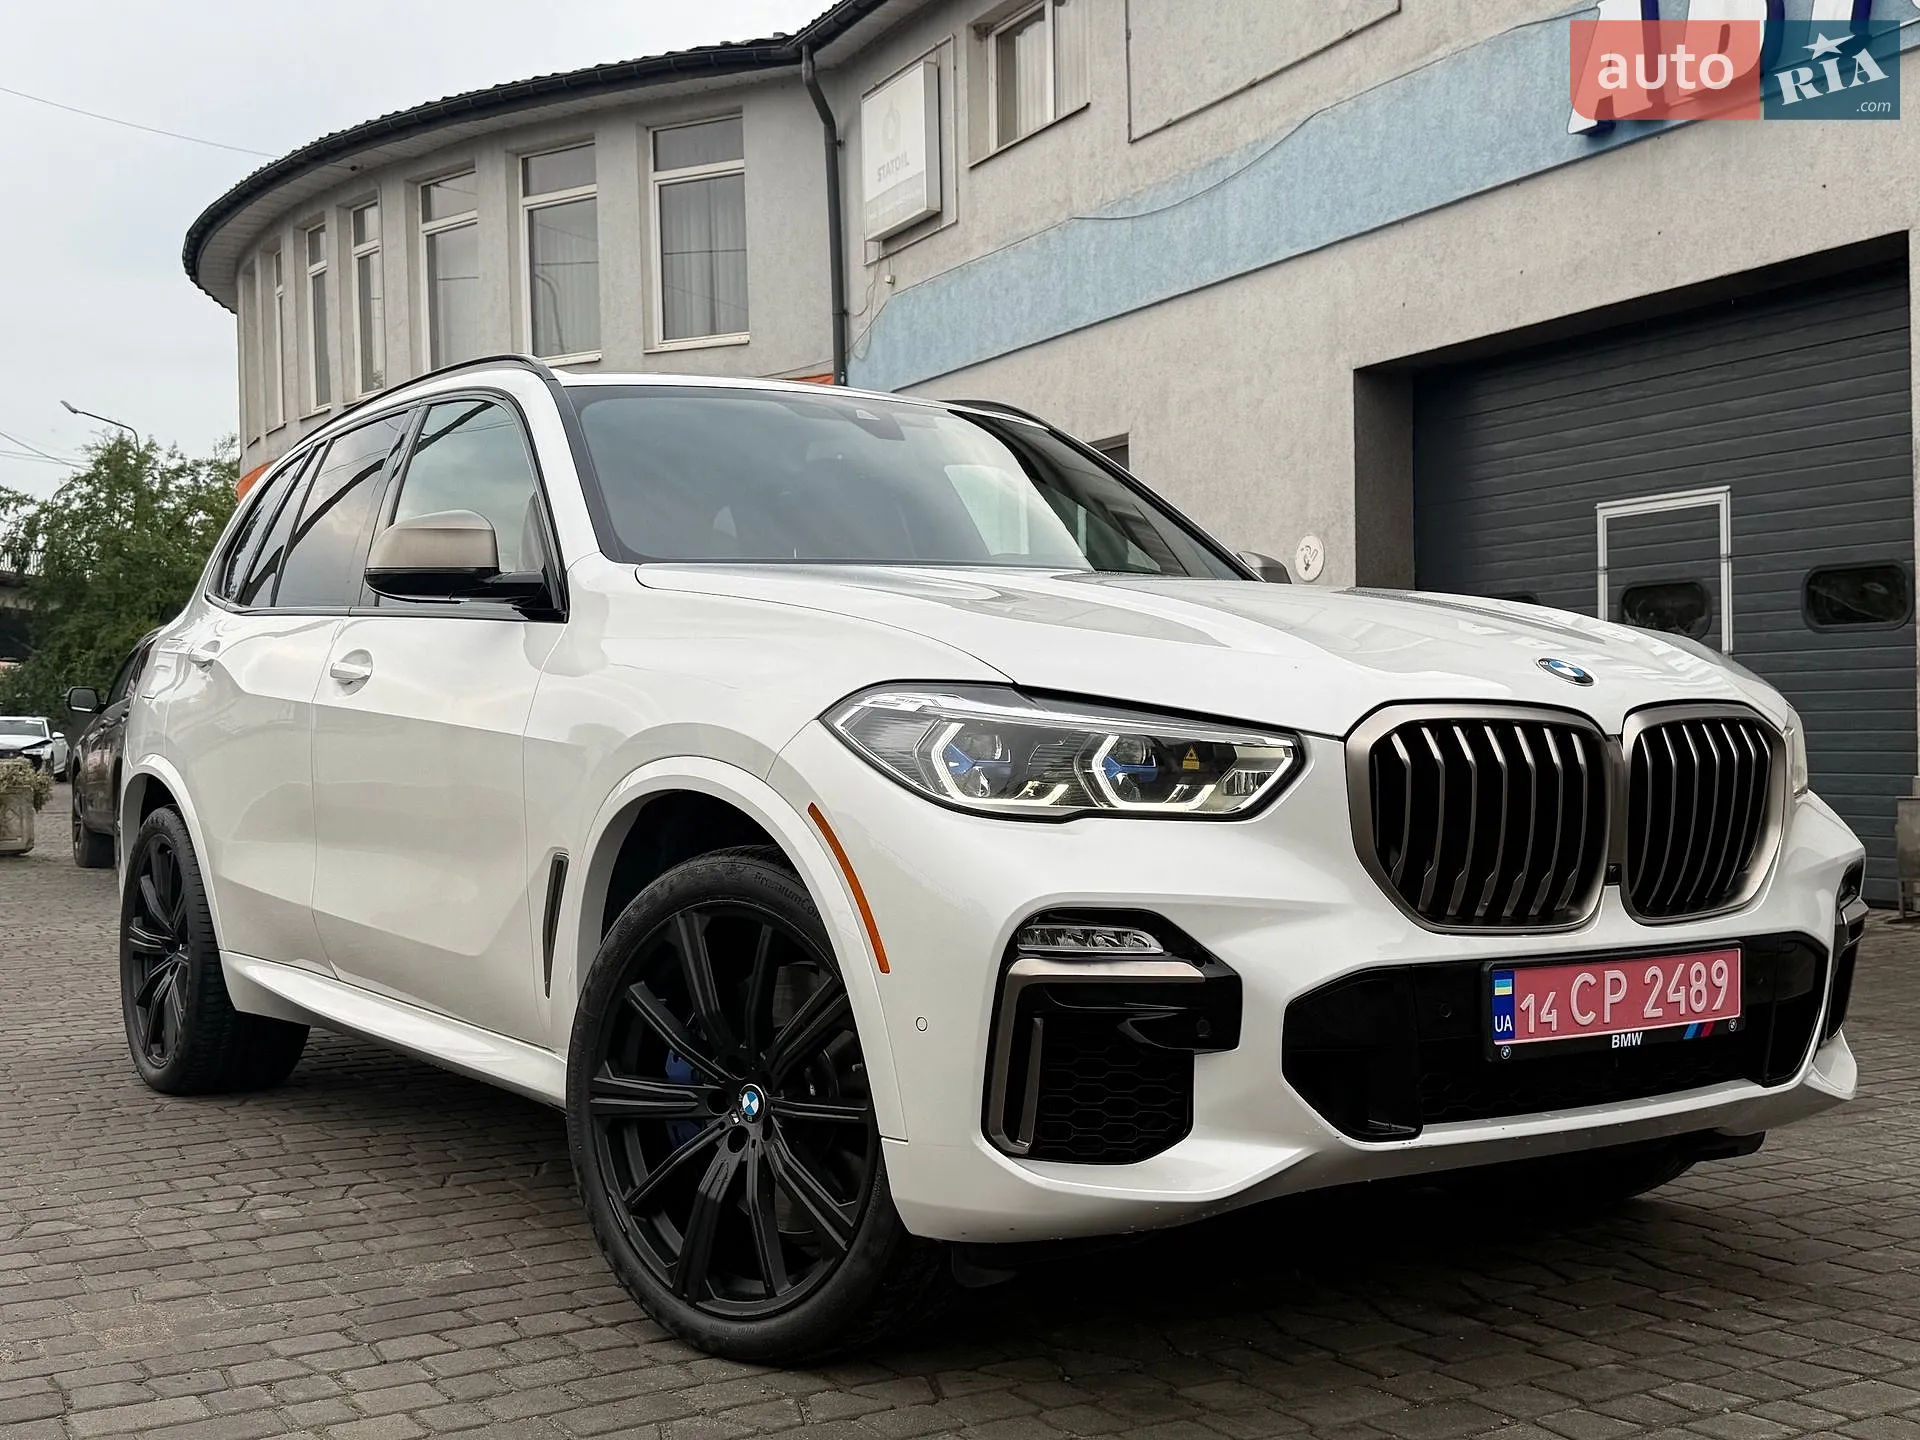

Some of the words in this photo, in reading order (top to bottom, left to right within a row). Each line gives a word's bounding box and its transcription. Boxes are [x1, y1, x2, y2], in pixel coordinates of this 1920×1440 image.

[877, 151, 910, 182] STATOIL
[1520, 992, 1557, 1033] 14
[1570, 970, 1627, 1026] CP
[1643, 959, 1729, 1019] 2489
[1494, 1014, 1513, 1033] UA
[1611, 1031, 1643, 1049] BMW
